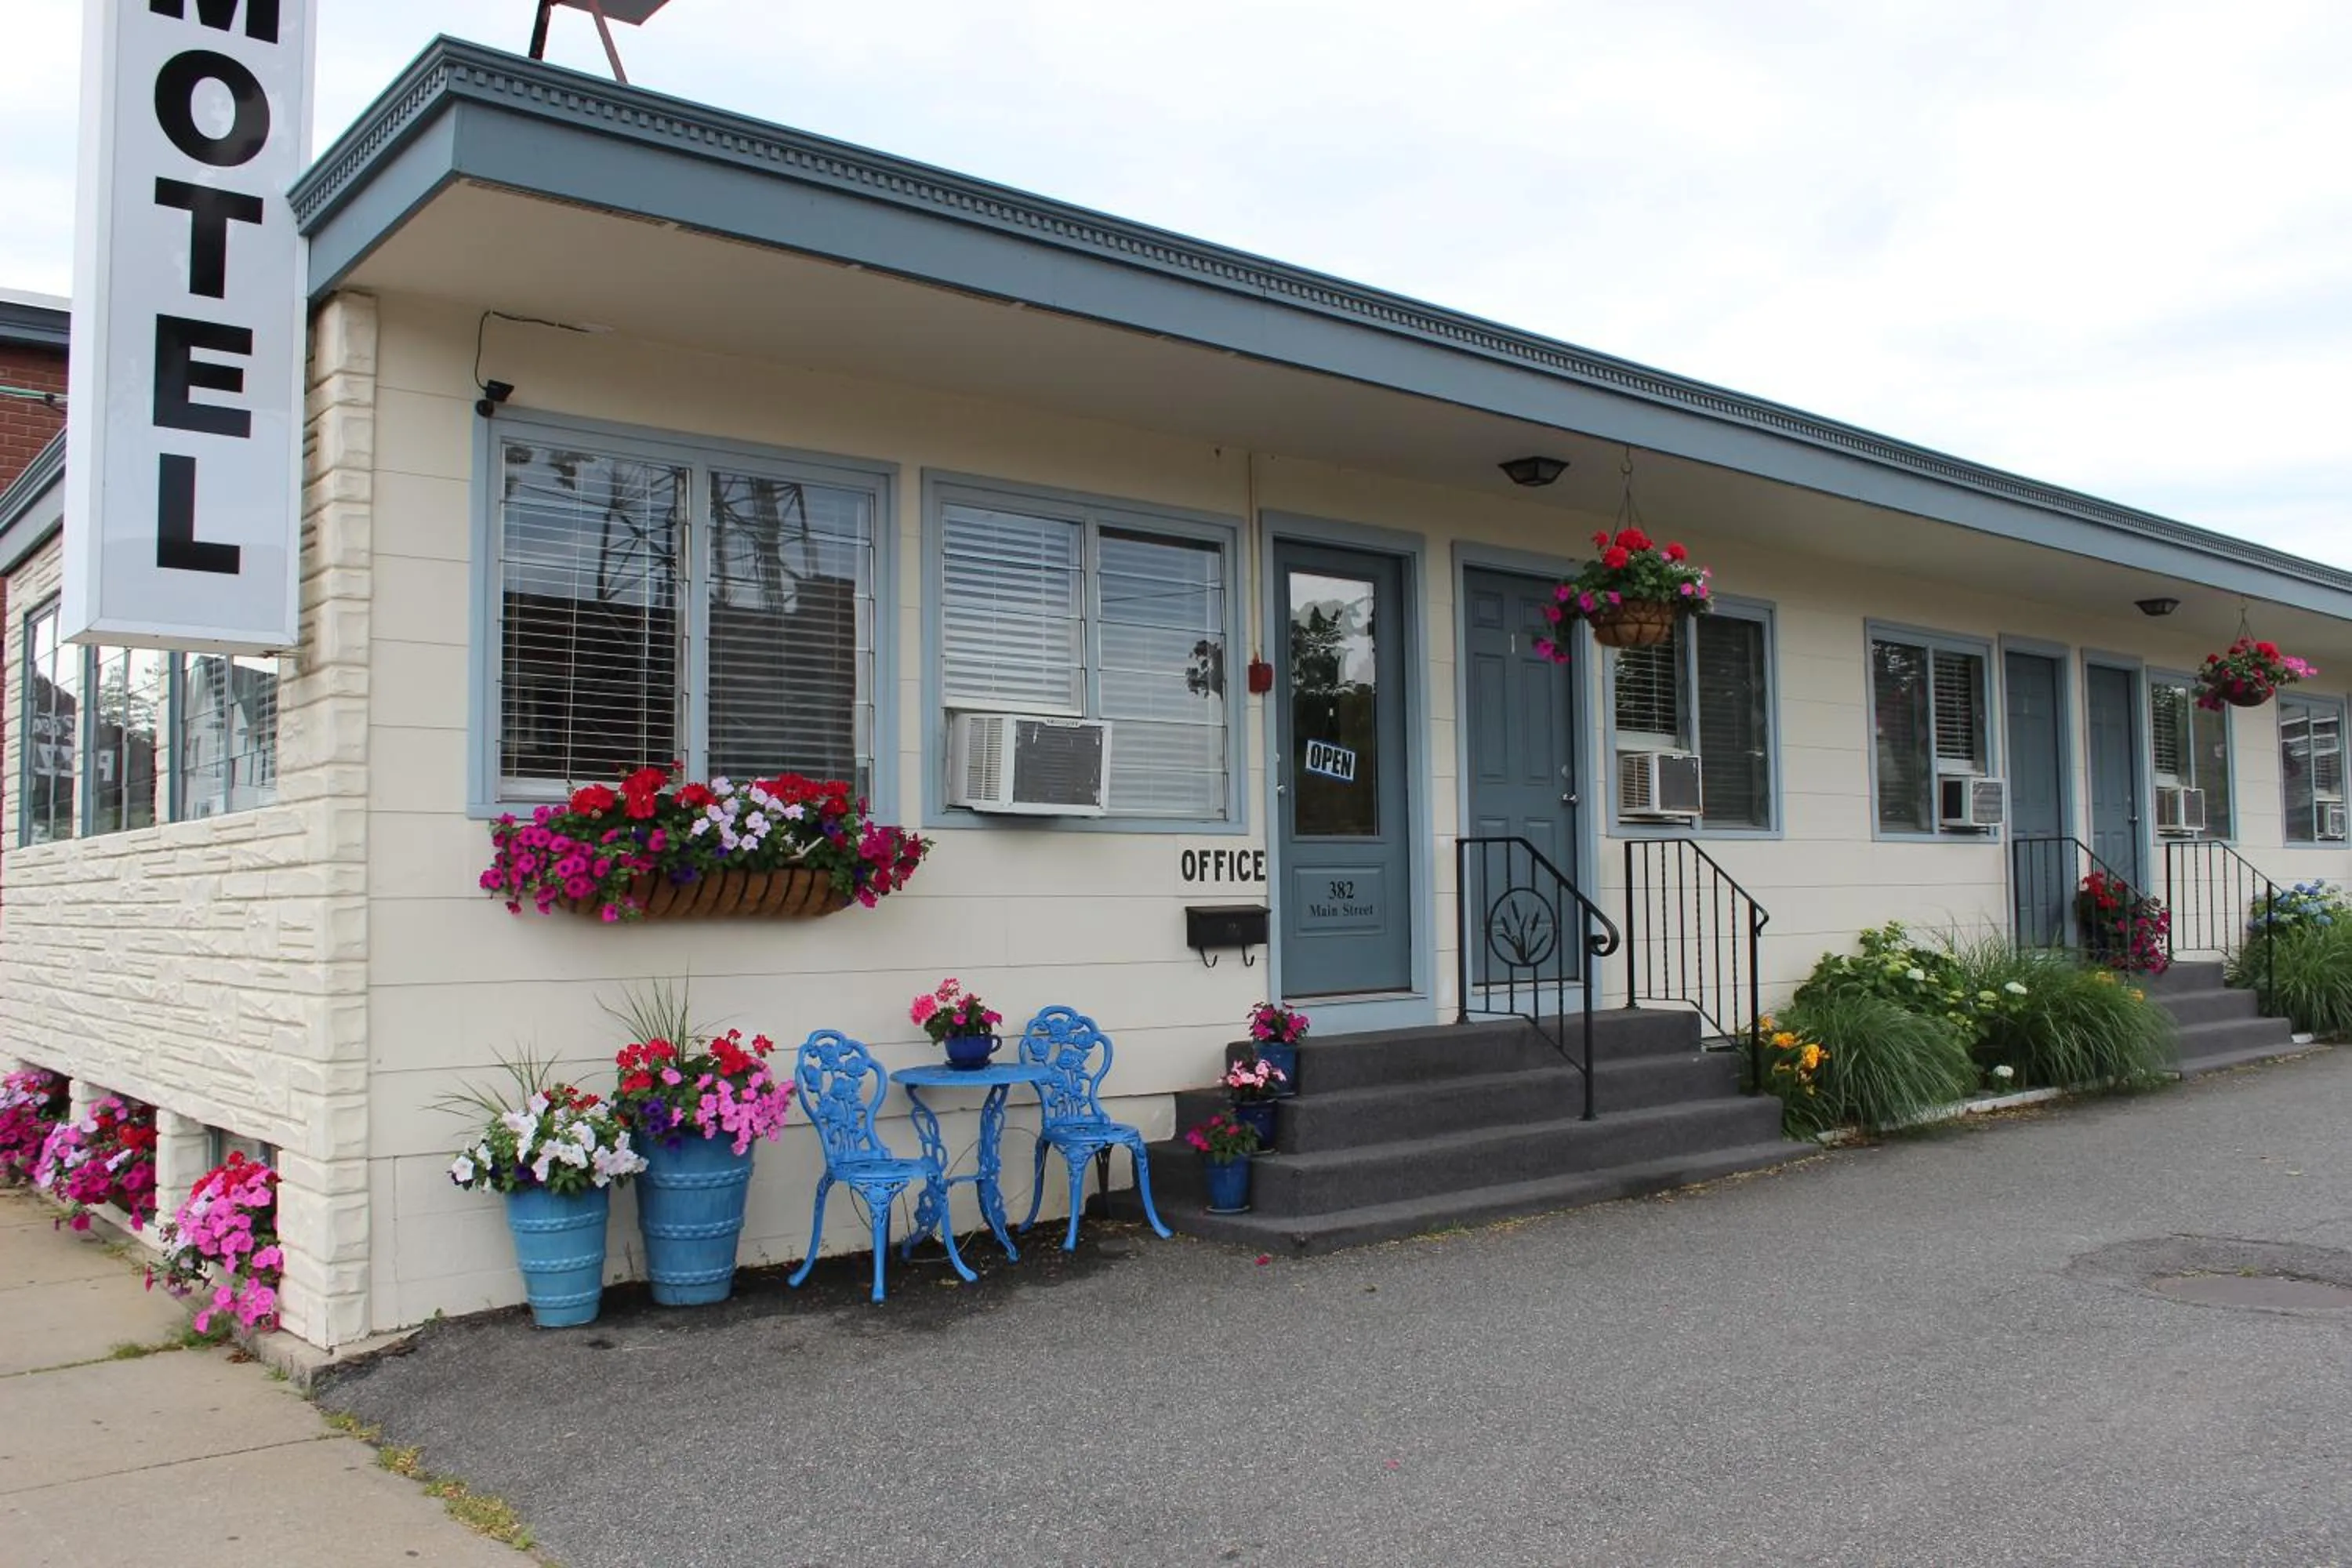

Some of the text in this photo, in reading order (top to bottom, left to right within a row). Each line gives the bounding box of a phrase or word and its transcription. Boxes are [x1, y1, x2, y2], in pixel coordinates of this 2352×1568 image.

[149, 0, 279, 575] OTEL
[1310, 744, 1352, 779] OPEN
[1181, 849, 1266, 882] OFFICE
[1329, 880, 1354, 900] 382
[1310, 903, 1374, 916] Main Street
